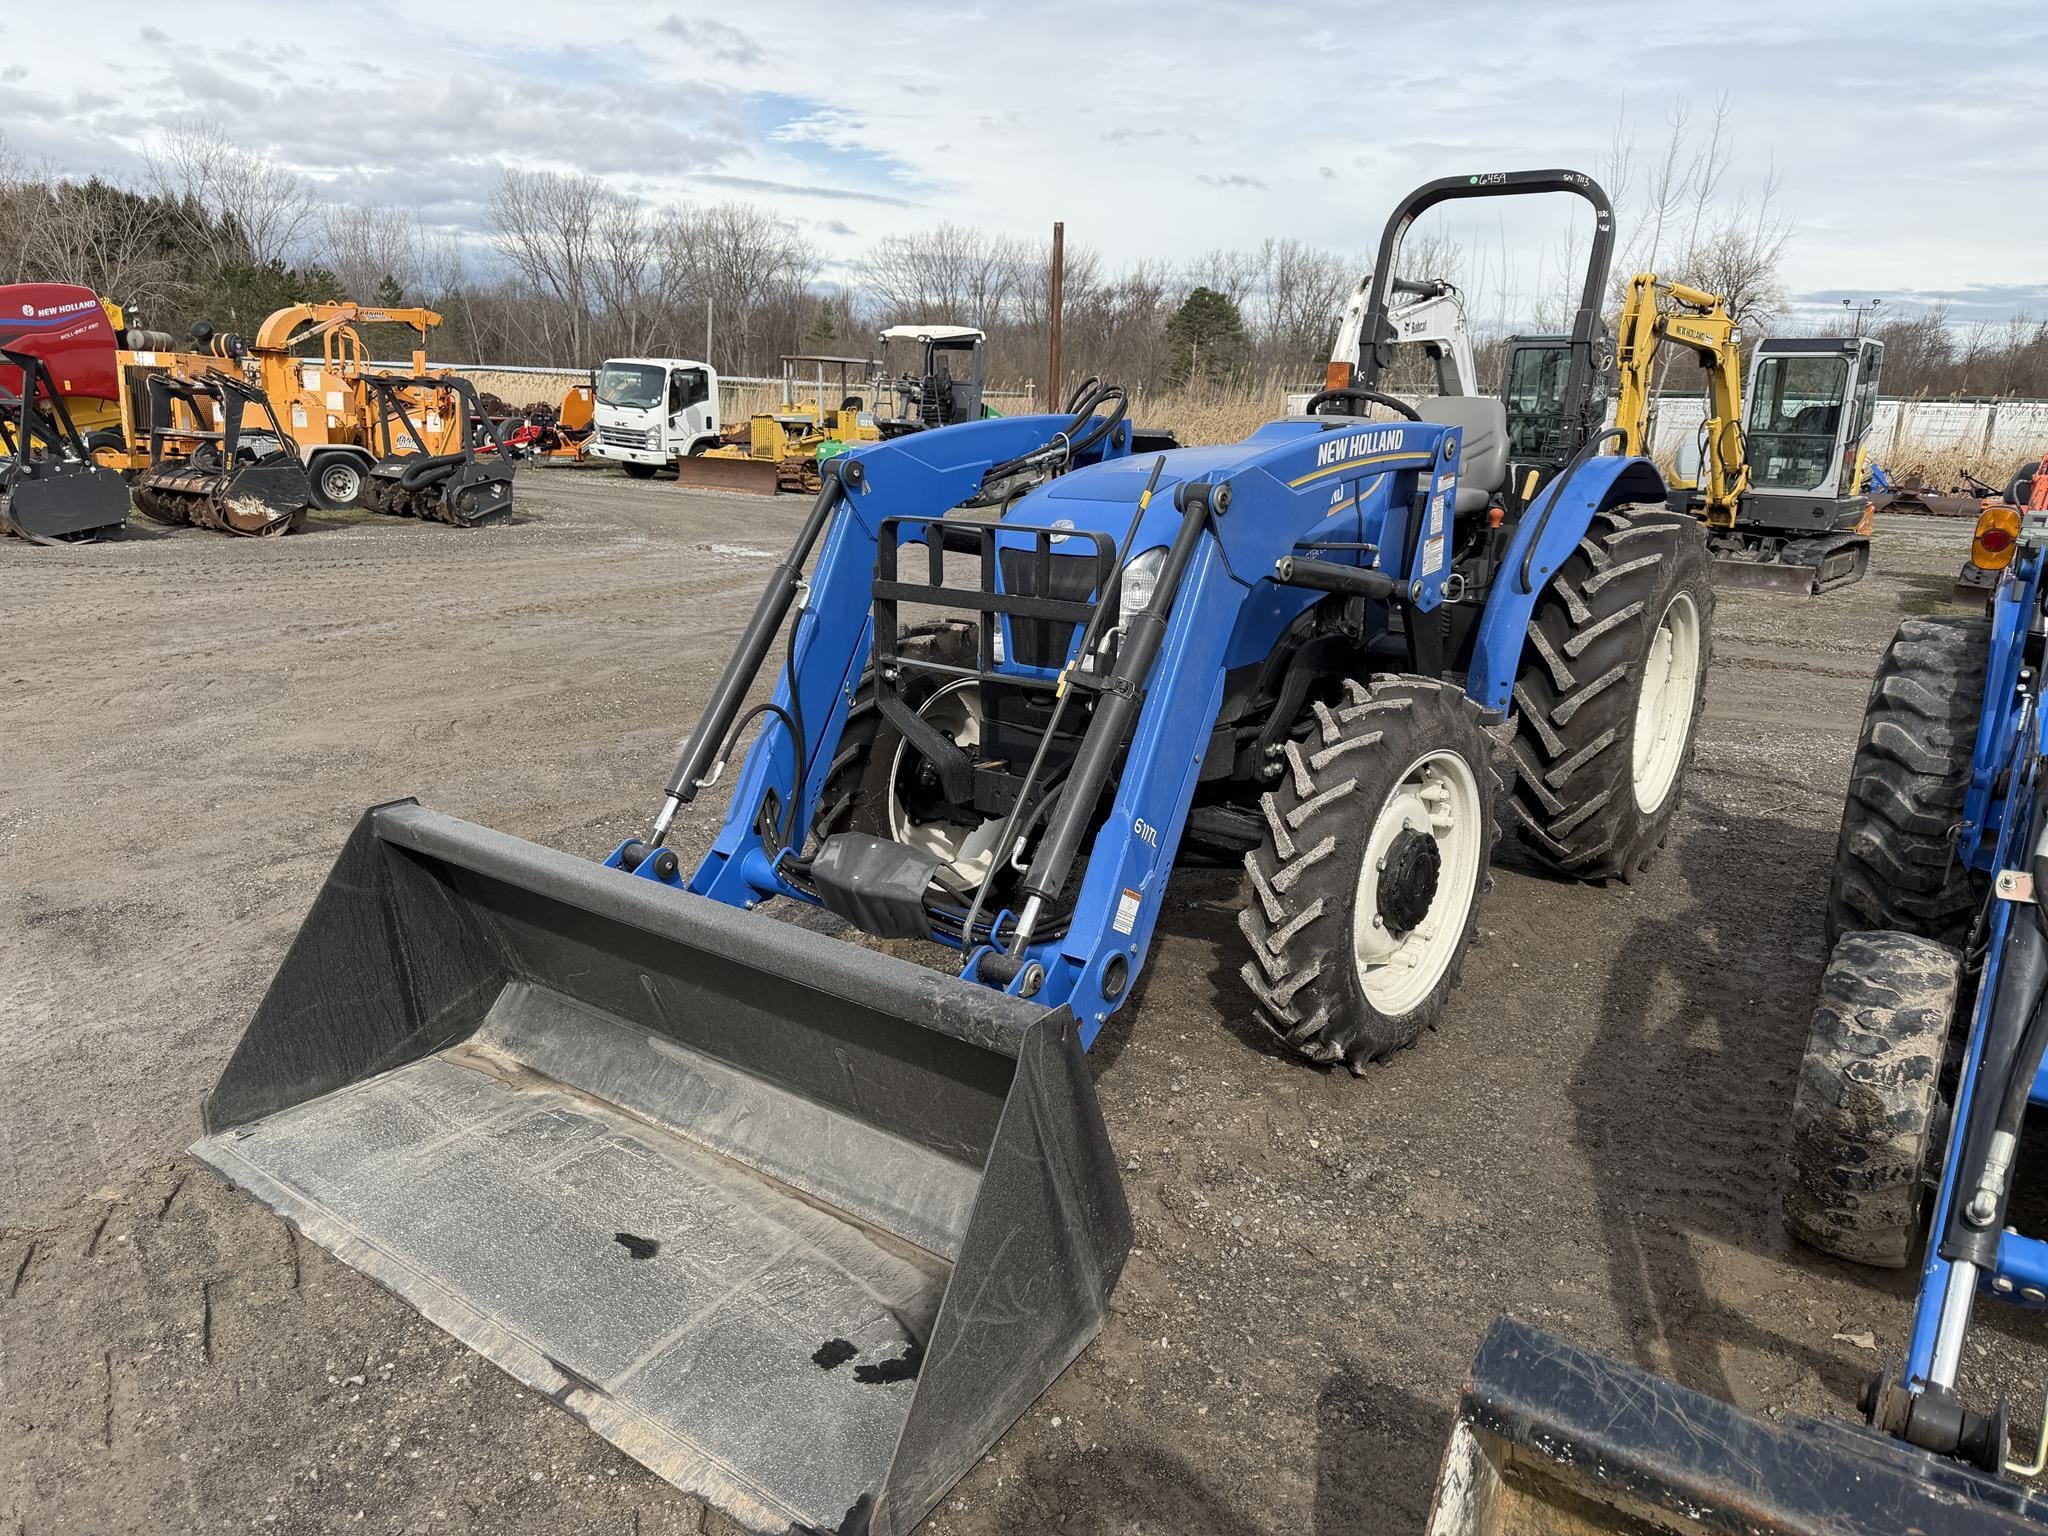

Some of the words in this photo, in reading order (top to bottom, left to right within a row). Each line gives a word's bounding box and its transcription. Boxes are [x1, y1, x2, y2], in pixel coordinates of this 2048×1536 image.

[1479, 173, 1506, 185] 6459
[38, 307, 57, 317] NEW
[59, 300, 96, 313] HOLLAND
[60, 326, 87, 340] ROLL-BELT
[1411, 320, 1427, 334] Bobcat
[1676, 325, 1686, 335] NEW
[1686, 328, 1705, 341] HOLLAND
[1317, 437, 1349, 467] NEW
[1349, 429, 1404, 458] HOLLAND
[1134, 817, 1158, 848] 611TL
